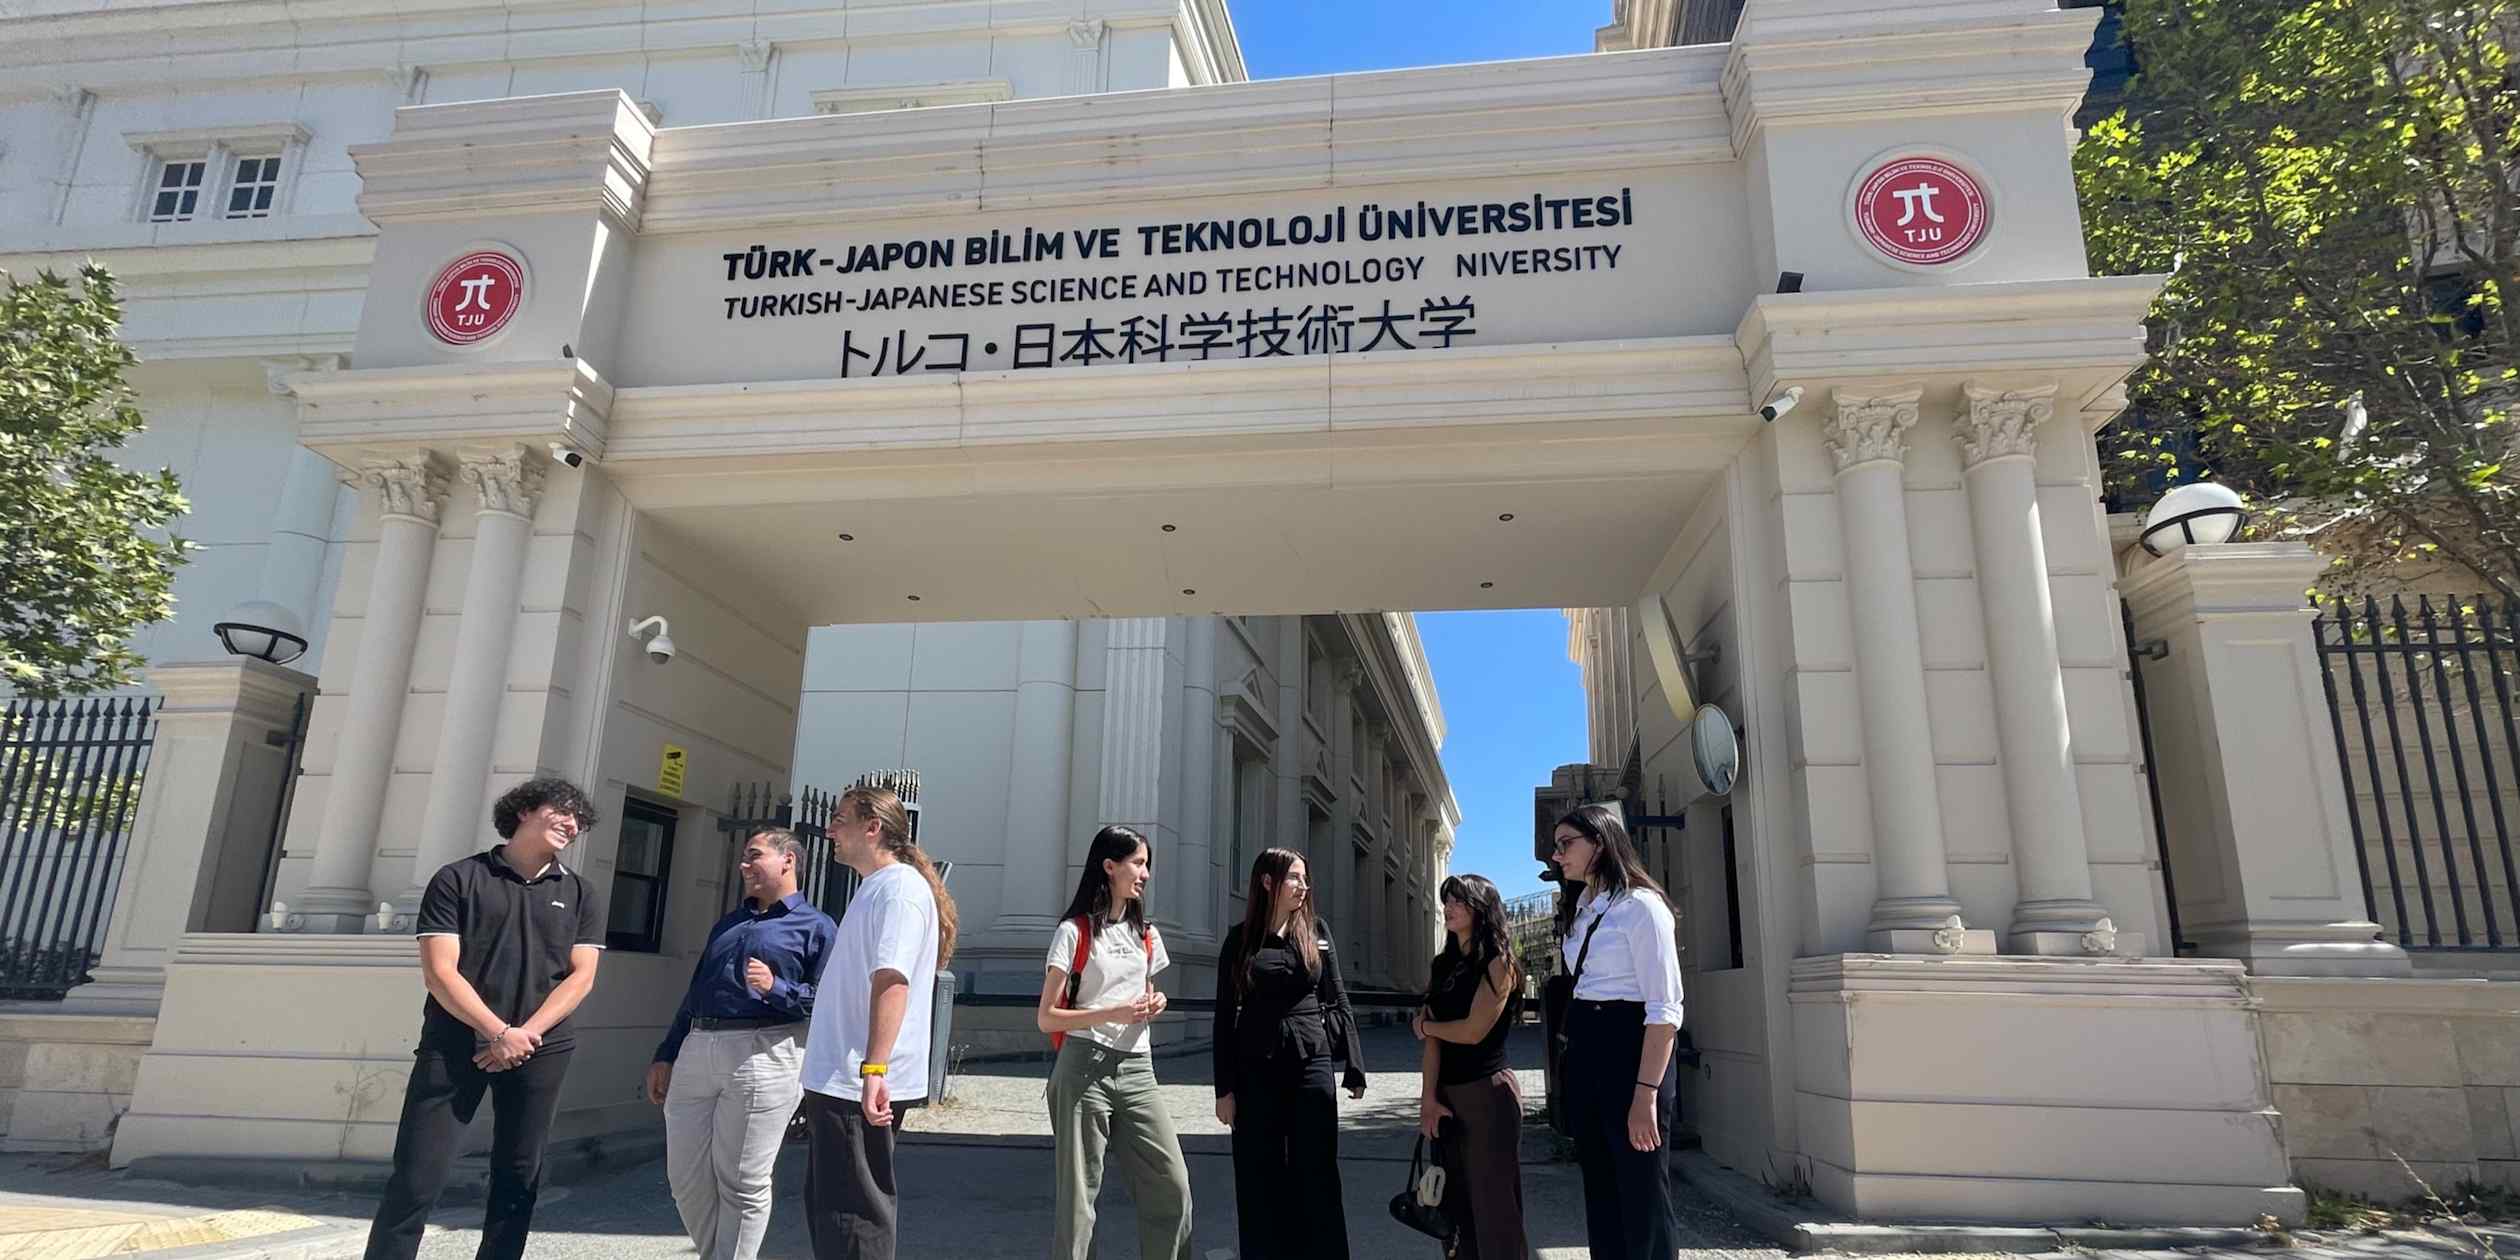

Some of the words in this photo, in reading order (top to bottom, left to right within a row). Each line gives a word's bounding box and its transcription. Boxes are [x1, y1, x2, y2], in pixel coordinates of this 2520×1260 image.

[965, 227, 1064, 266] BİLİM
[1073, 228, 1121, 259] VE
[1138, 205, 1345, 256] TEKNOLOJİ
[1359, 187, 1633, 241] ÜNİVERSİTESİ
[1903, 227, 1941, 243] TJU
[724, 281, 1004, 319] TURKISH-JAPANESE
[1010, 274, 1138, 304] SCIENCE
[1143, 271, 1207, 298] AND
[1216, 256, 1424, 293] TECHNOLOGY
[457, 313, 485, 326] TJU
[841, 295, 1476, 378] トルコ・日本科学技術大学
